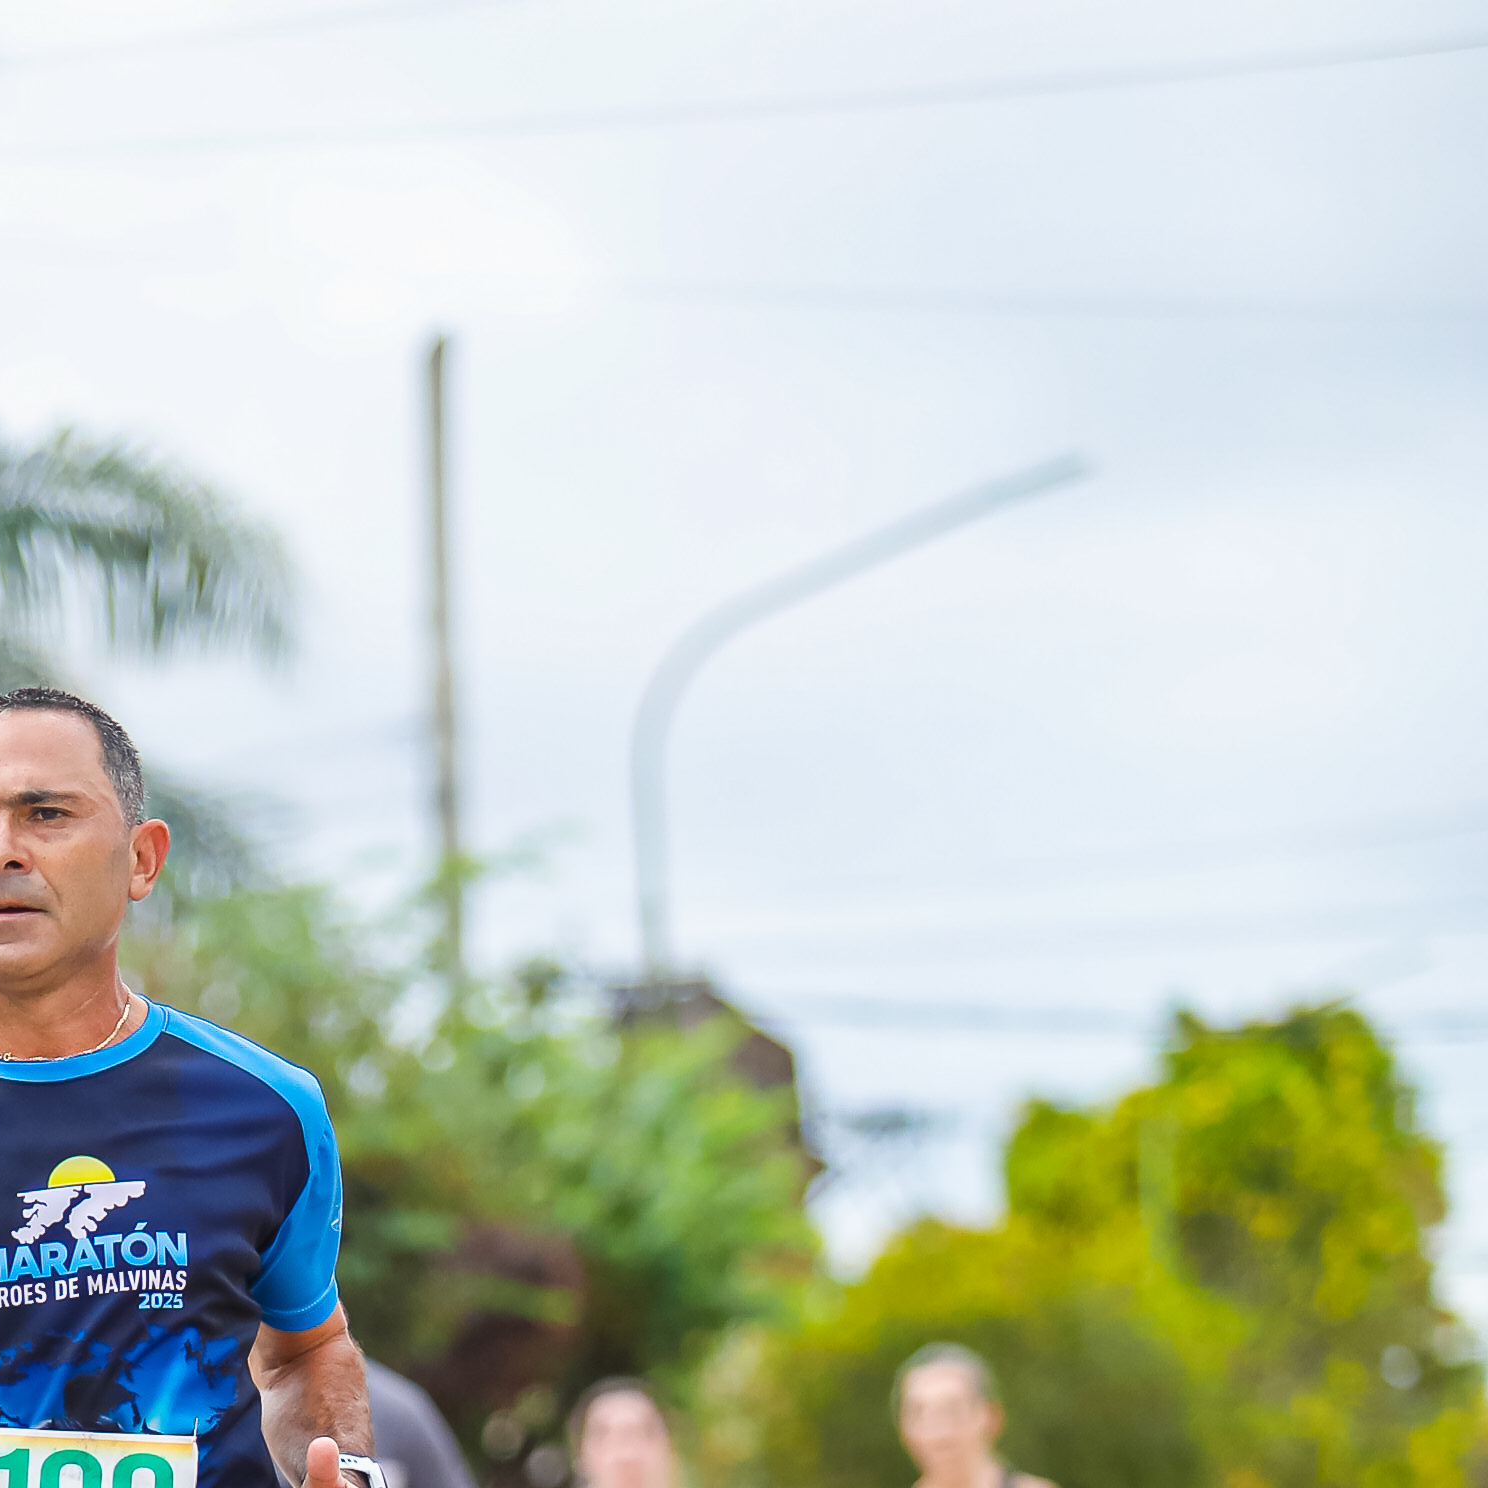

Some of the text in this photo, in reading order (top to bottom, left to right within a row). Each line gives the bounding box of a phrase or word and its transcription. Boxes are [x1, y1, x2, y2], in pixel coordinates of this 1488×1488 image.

[54, 1275, 80, 1302] DE
[87, 1269, 187, 1296] MALVINAS
[137, 1292, 184, 1310] 2025
